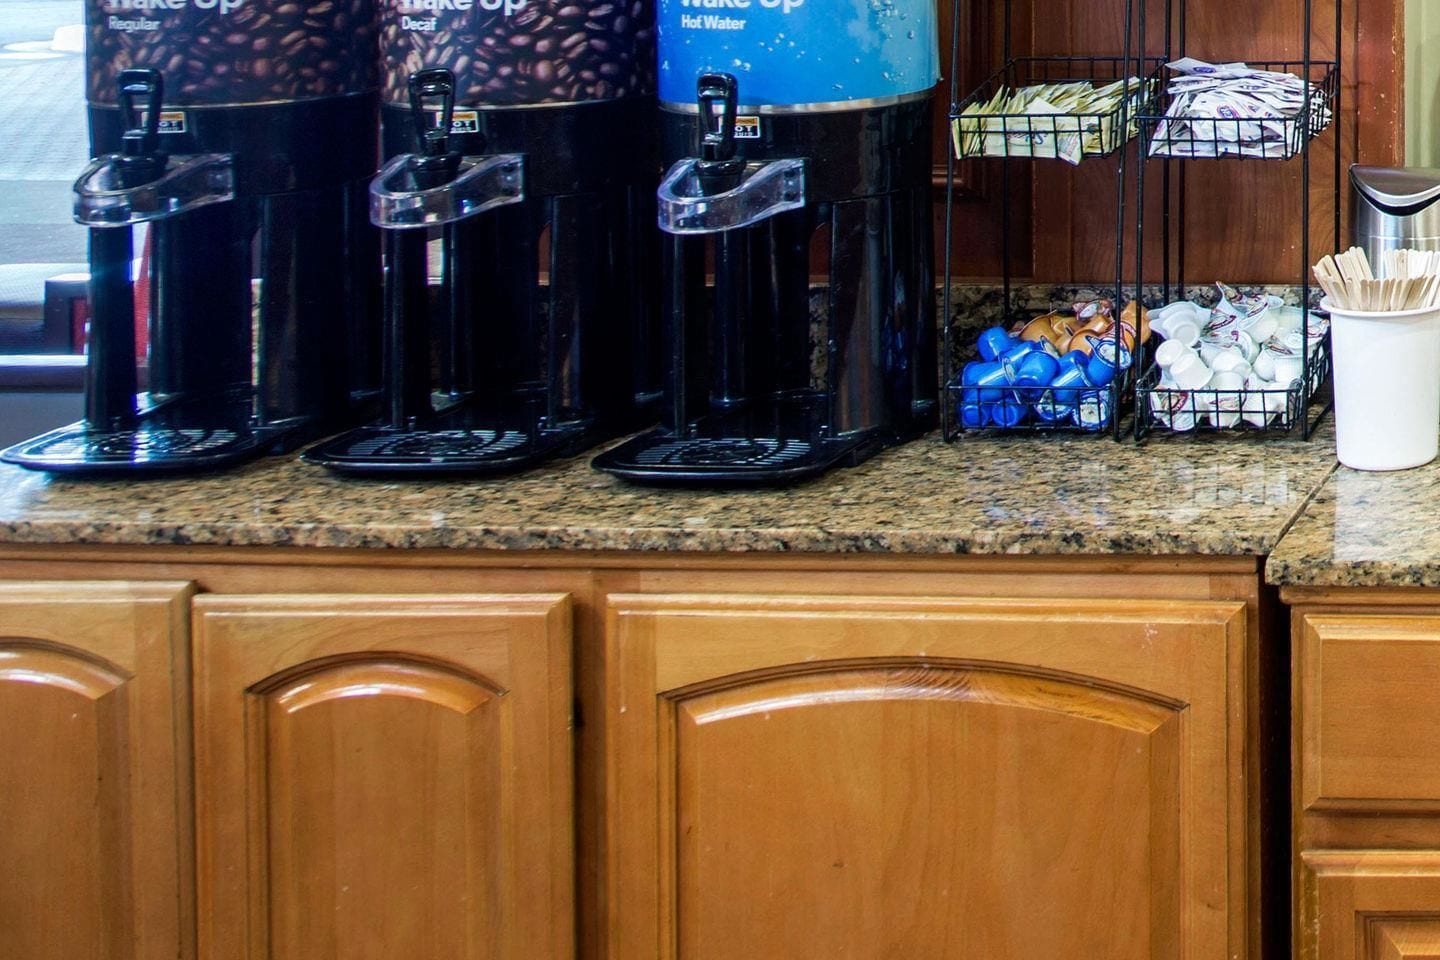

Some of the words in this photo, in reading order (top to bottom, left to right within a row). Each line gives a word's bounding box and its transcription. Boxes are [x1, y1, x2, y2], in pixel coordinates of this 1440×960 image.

[109, 15, 161, 33] Regular
[402, 15, 437, 31] Decaf
[681, 14, 703, 29] Hot
[703, 14, 746, 30] Water
